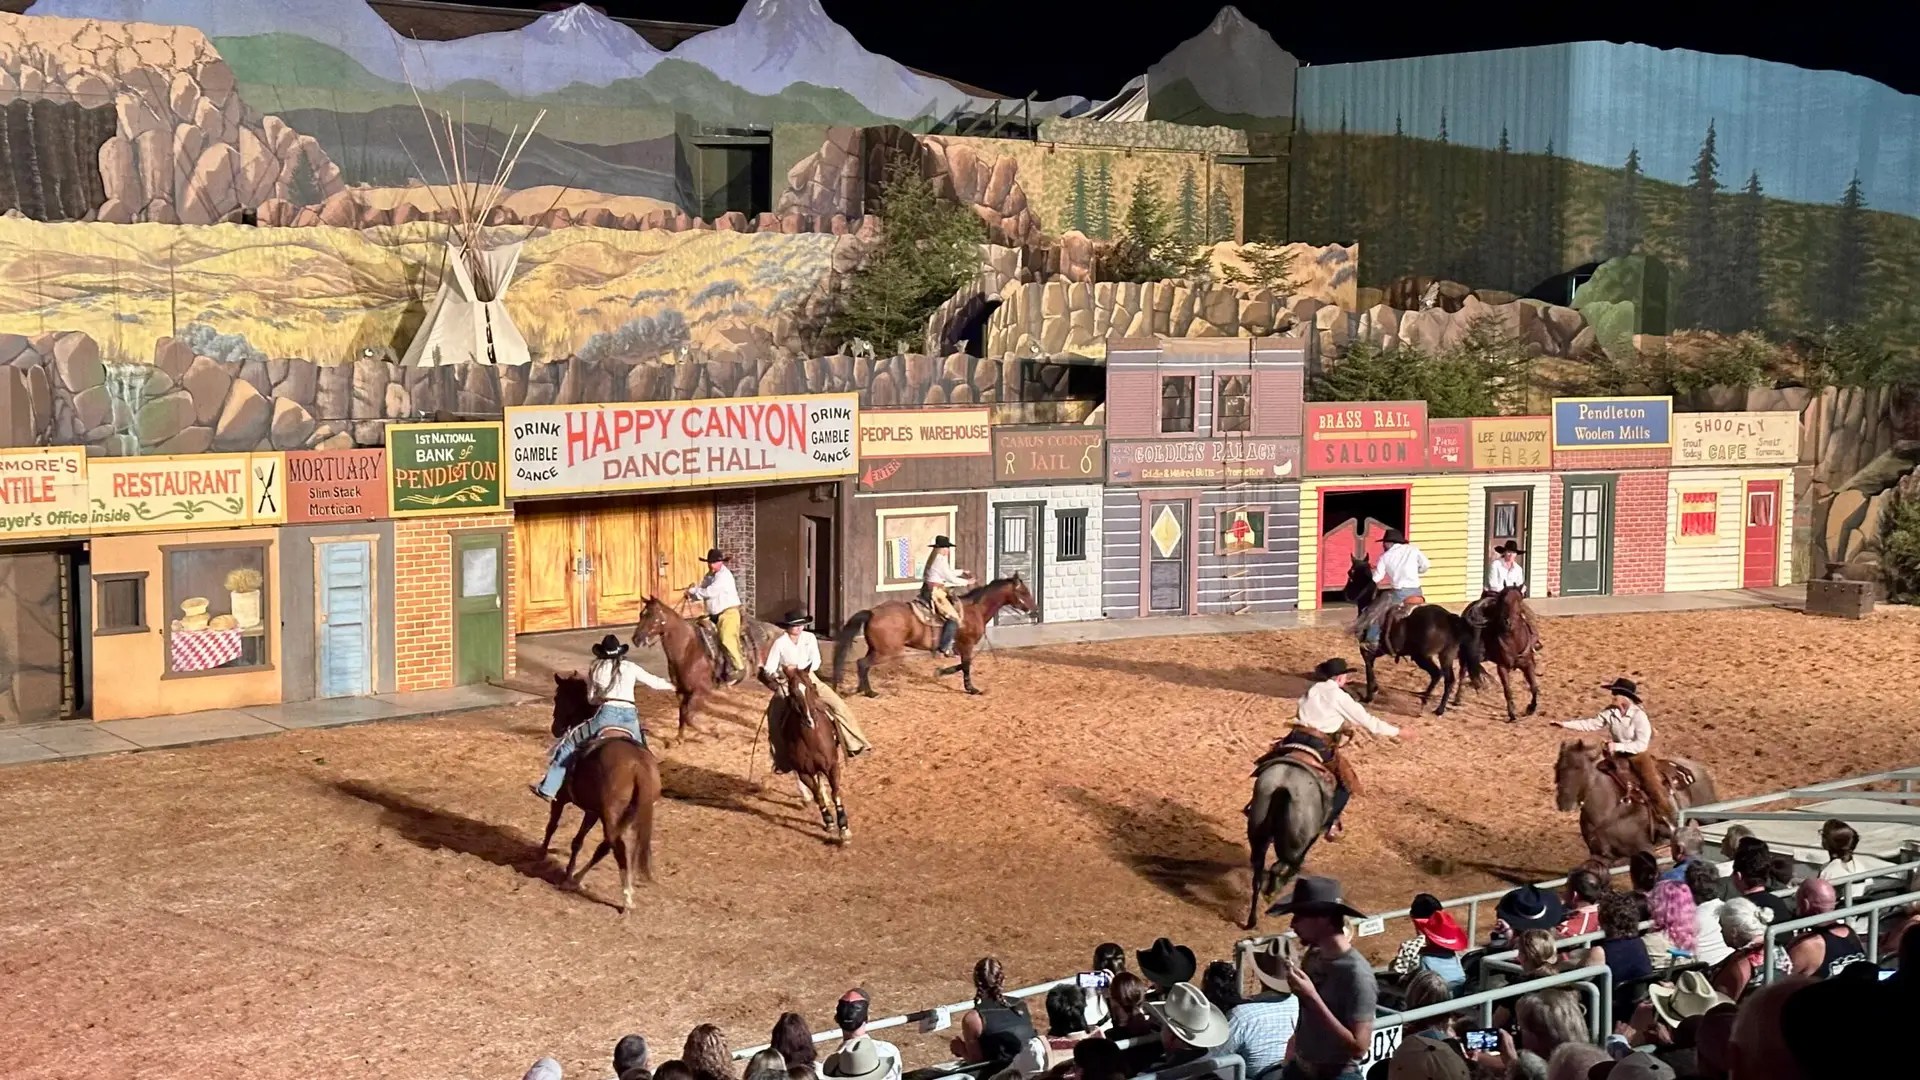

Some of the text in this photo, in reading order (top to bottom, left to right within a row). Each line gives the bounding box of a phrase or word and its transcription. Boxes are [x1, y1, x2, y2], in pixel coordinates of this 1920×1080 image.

[811, 408, 852, 424] DRINK
[1319, 410, 1411, 429] BRASS RAIL
[1579, 404, 1645, 420] Pendleton
[432, 432, 476, 444] NATIONAL
[514, 421, 561, 440] DRINK
[565, 403, 807, 468] HAPPY CANYON
[811, 429, 850, 445] GAMBLE
[920, 425, 988, 440] WAREHOUSE
[1478, 430, 1547, 444] LEE LAUNDRY
[1575, 425, 1650, 440] Woolen Mills
[1001, 434, 1099, 448] CAMUS COUNTY
[415, 445, 474, 462] BANK of
[515, 446, 558, 462] GAMBLE
[813, 447, 851, 463] DANCE
[1212, 441, 1276, 461] PALACE
[1326, 442, 1407, 463] SALOON
[1708, 443, 1747, 460] CAFE
[289, 451, 383, 482] MORTUARY
[603, 446, 776, 480] DANCE HALL
[1030, 452, 1070, 470] JAIL
[396, 460, 497, 489] PENDLETON
[516, 466, 559, 481] DANCE
[872, 460, 902, 480] ENTER
[113, 468, 241, 498] RESTAURANT
[309, 485, 362, 499] Slim Stack
[47, 511, 88, 525] Office
[91, 509, 130, 523] inside
[309, 502, 362, 516] Mortician
[1359, 1028, 1399, 1065] OX
